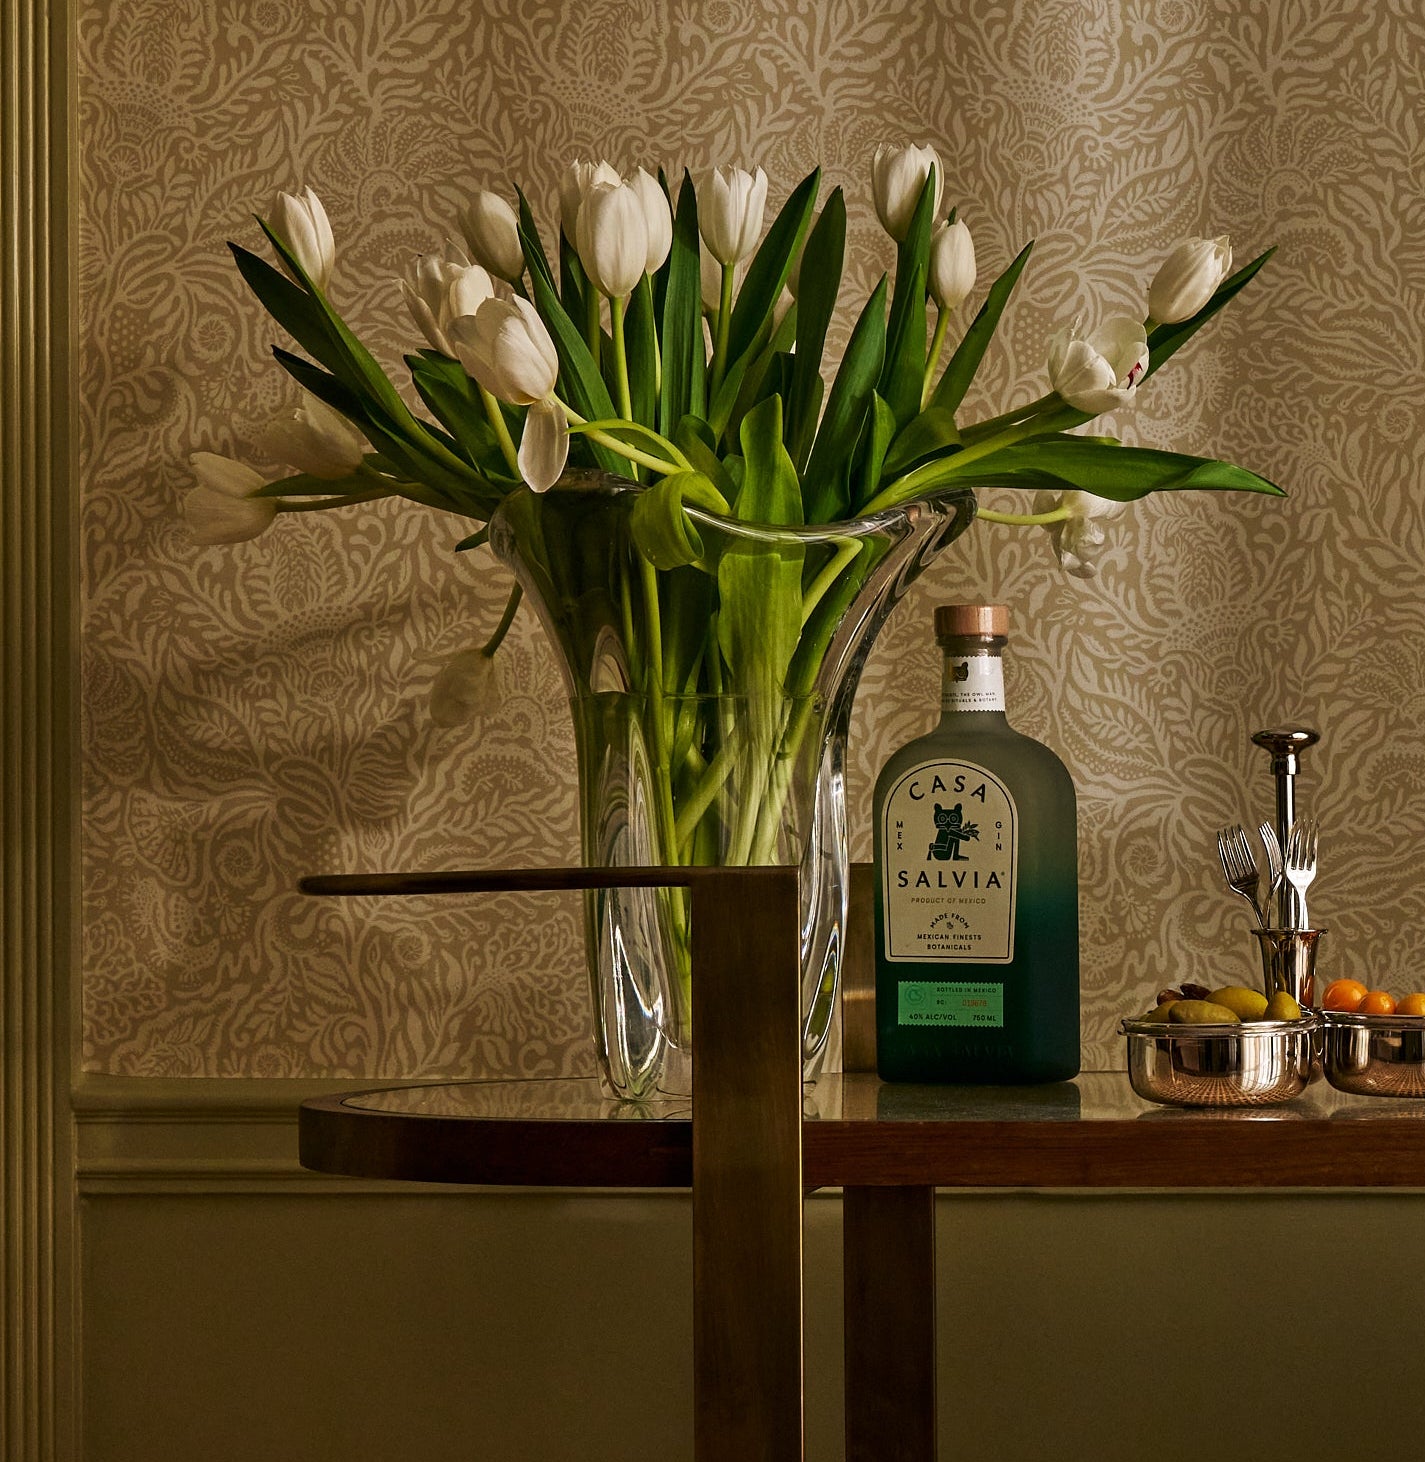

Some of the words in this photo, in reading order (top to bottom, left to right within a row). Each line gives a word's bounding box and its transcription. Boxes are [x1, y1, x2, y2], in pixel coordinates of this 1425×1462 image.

[909, 775, 987, 803] CASA
[896, 820, 904, 851] MEX
[995, 821, 1003, 851] GIN
[897, 870, 1002, 889] SALVIA
[929, 913, 948, 929] MADE
[951, 913, 970, 929] FROM
[917, 933, 950, 941] MEXICAN
[926, 943, 972, 951] BOTANICALS
[925, 1013, 957, 1021] ALC/VOL
